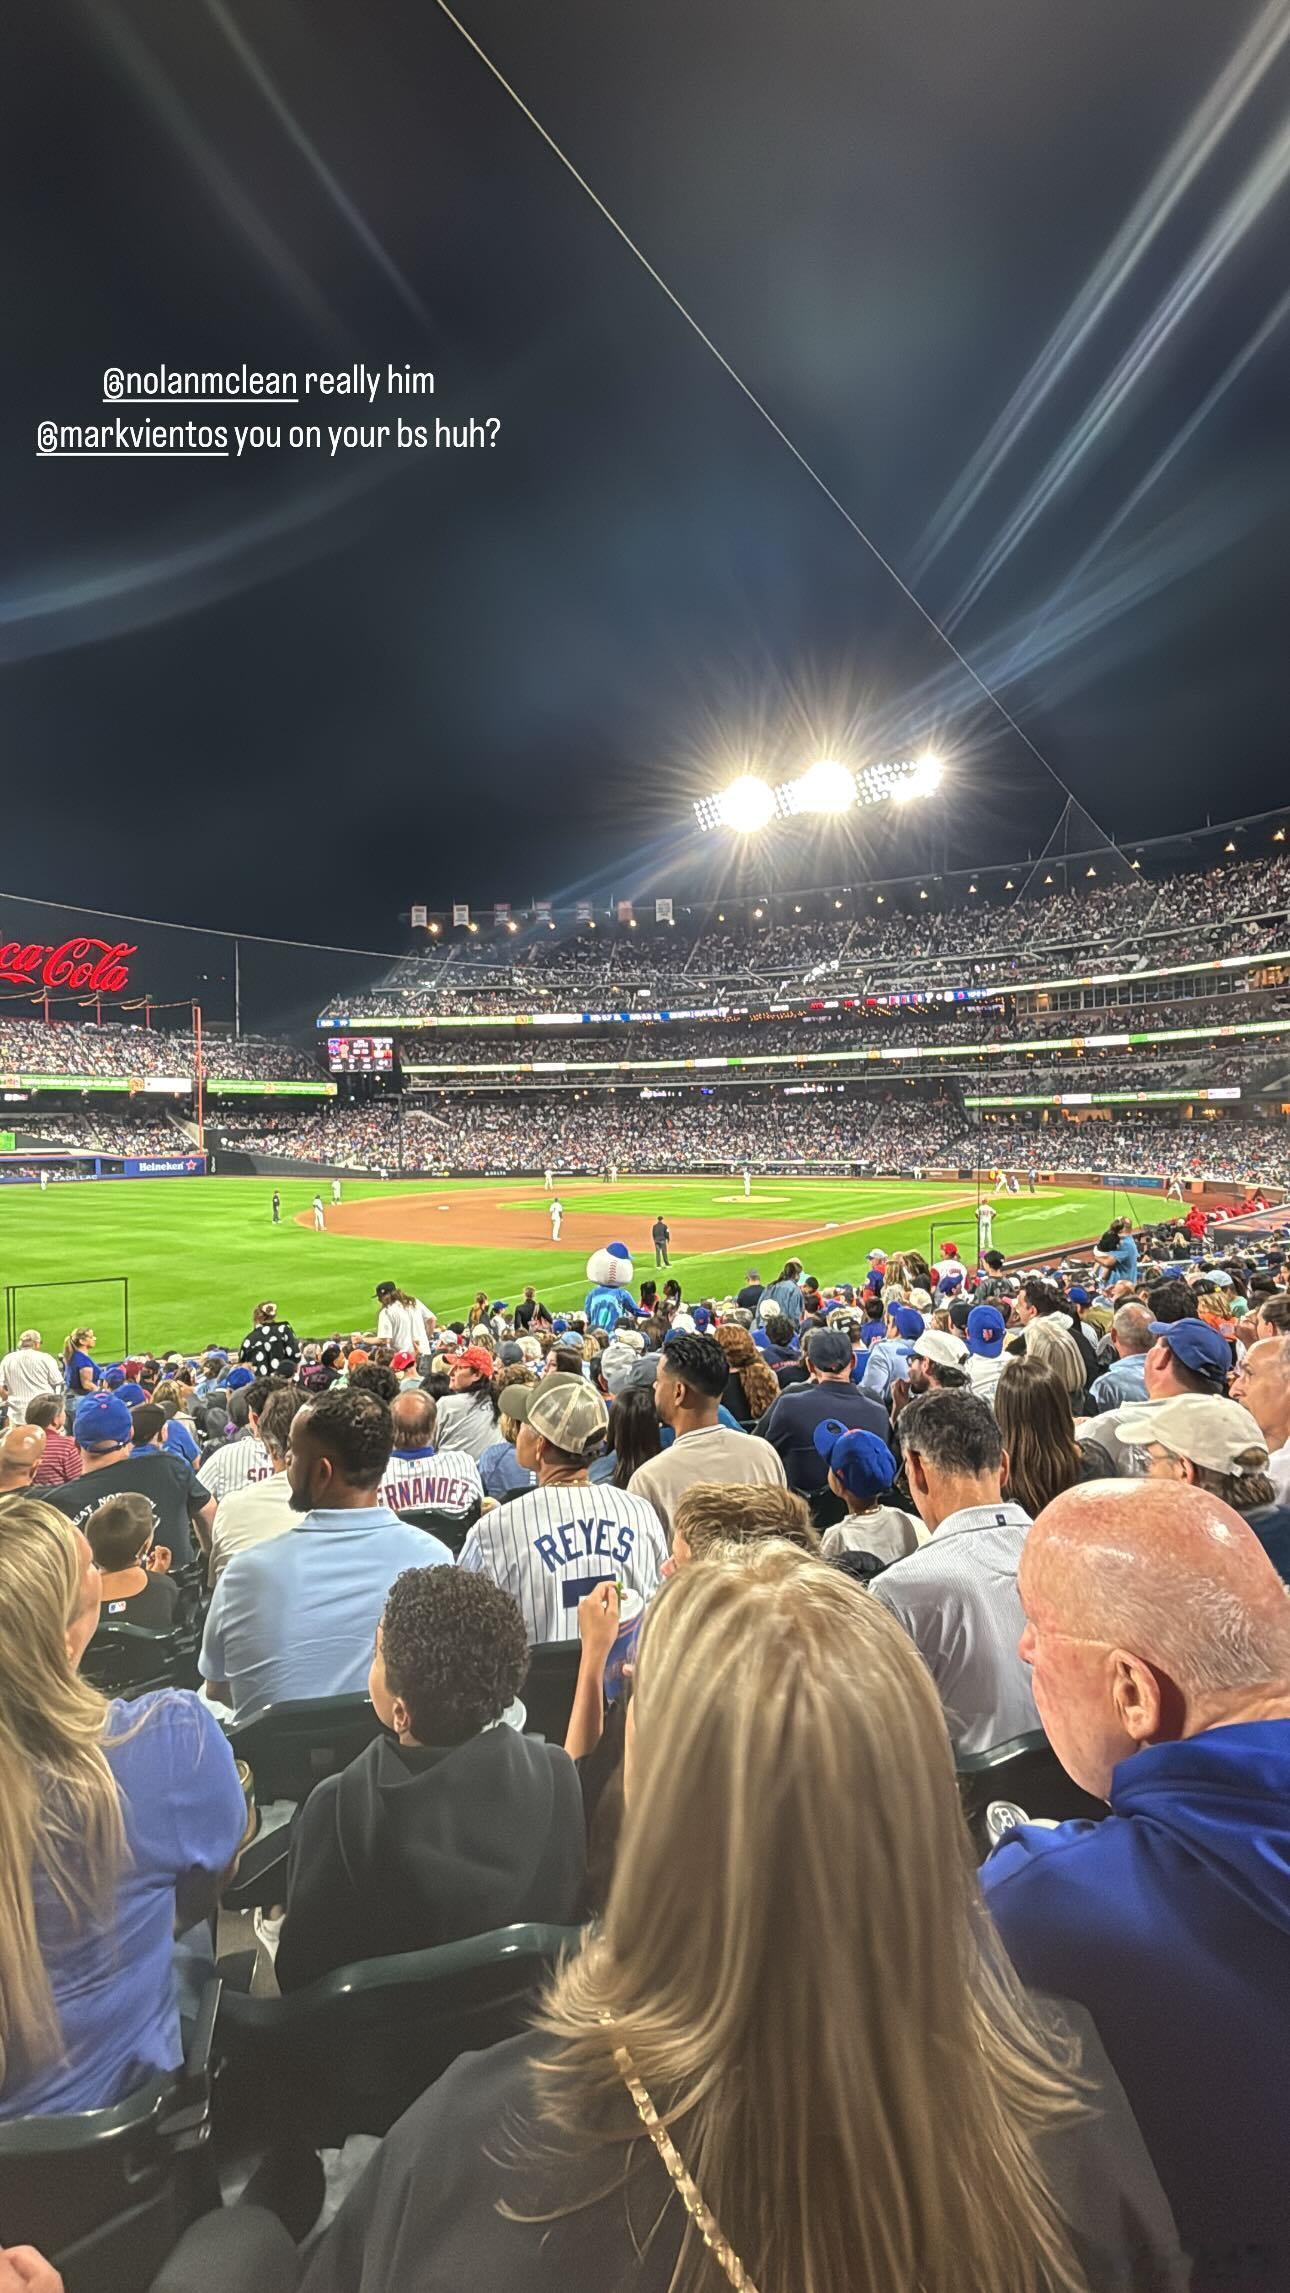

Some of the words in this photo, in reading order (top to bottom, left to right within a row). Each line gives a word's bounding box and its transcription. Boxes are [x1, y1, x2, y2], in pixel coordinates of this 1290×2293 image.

[139, 1161, 184, 1172] Heineken
[52, 1174, 98, 1182] CADILLAC
[533, 1517, 635, 1573] REYES
